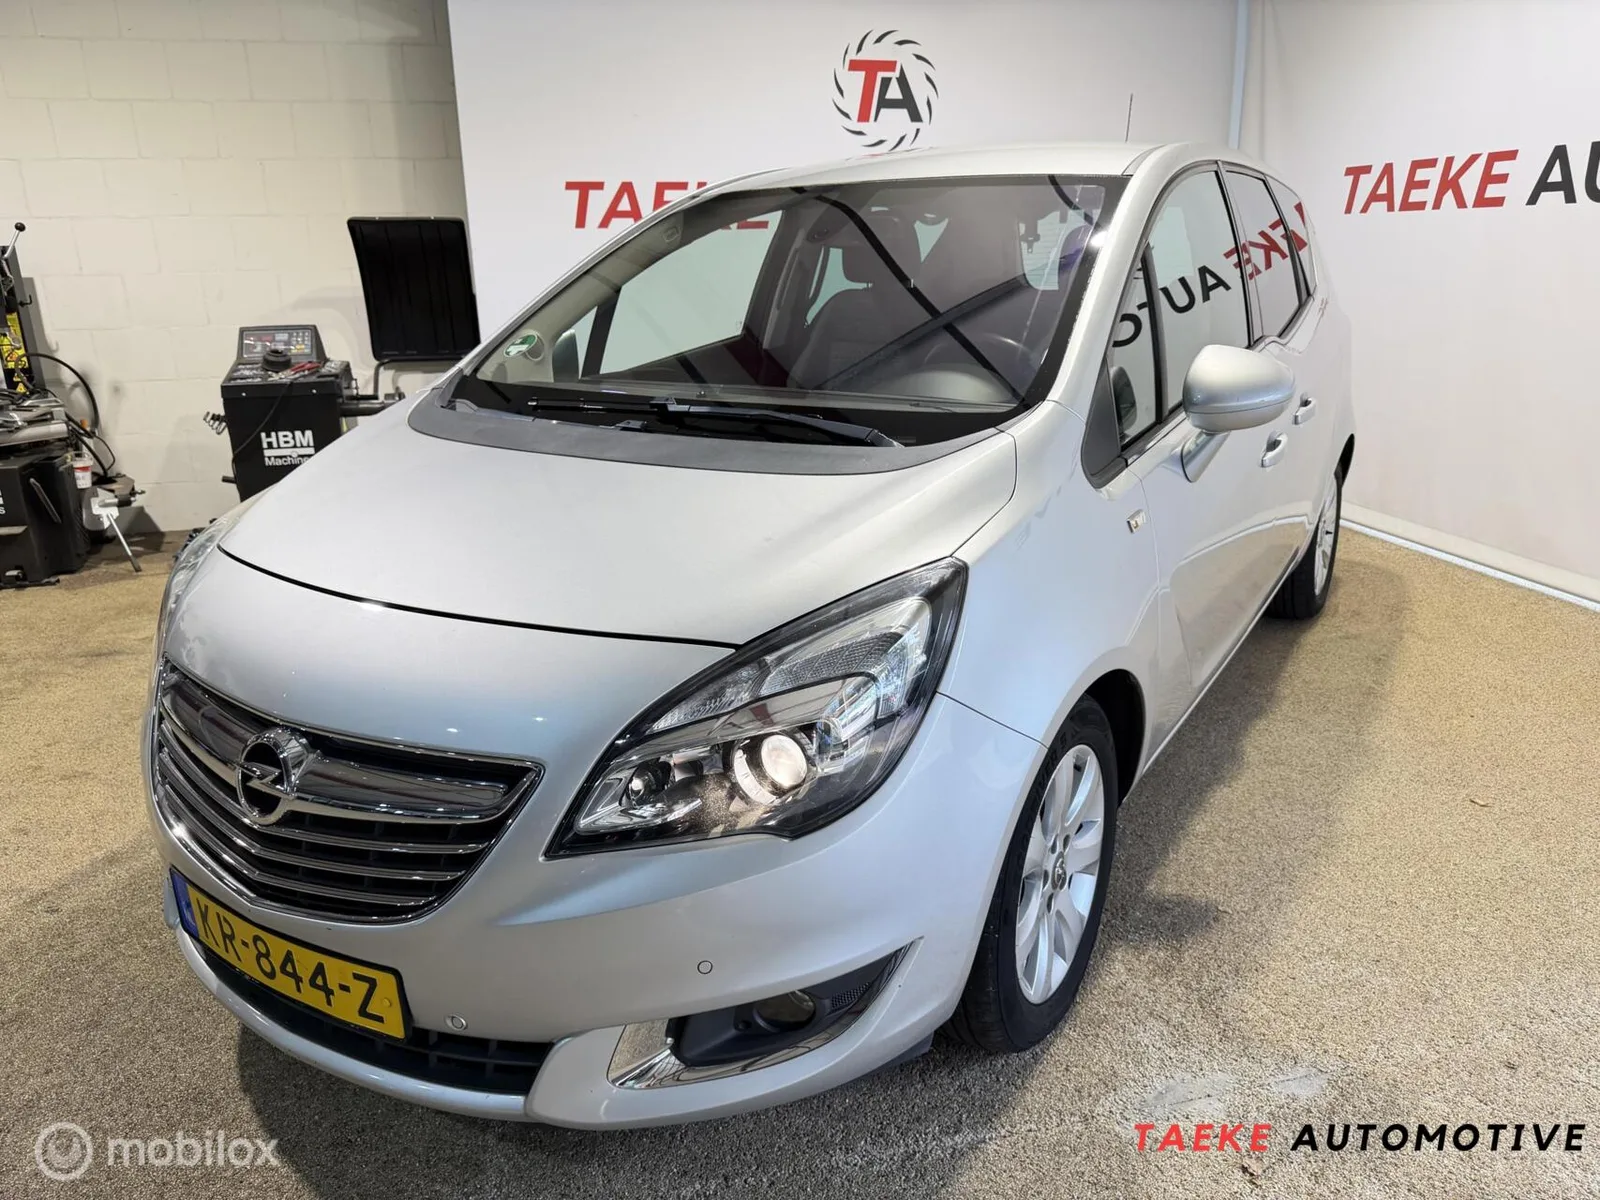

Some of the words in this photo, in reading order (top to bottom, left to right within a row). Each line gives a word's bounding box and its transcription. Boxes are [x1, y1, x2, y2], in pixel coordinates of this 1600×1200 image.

[847, 59, 923, 123] TA
[1343, 149, 1519, 214] TAEKE
[260, 429, 314, 449] HBM
[196, 897, 385, 1024] KR-844-Z
